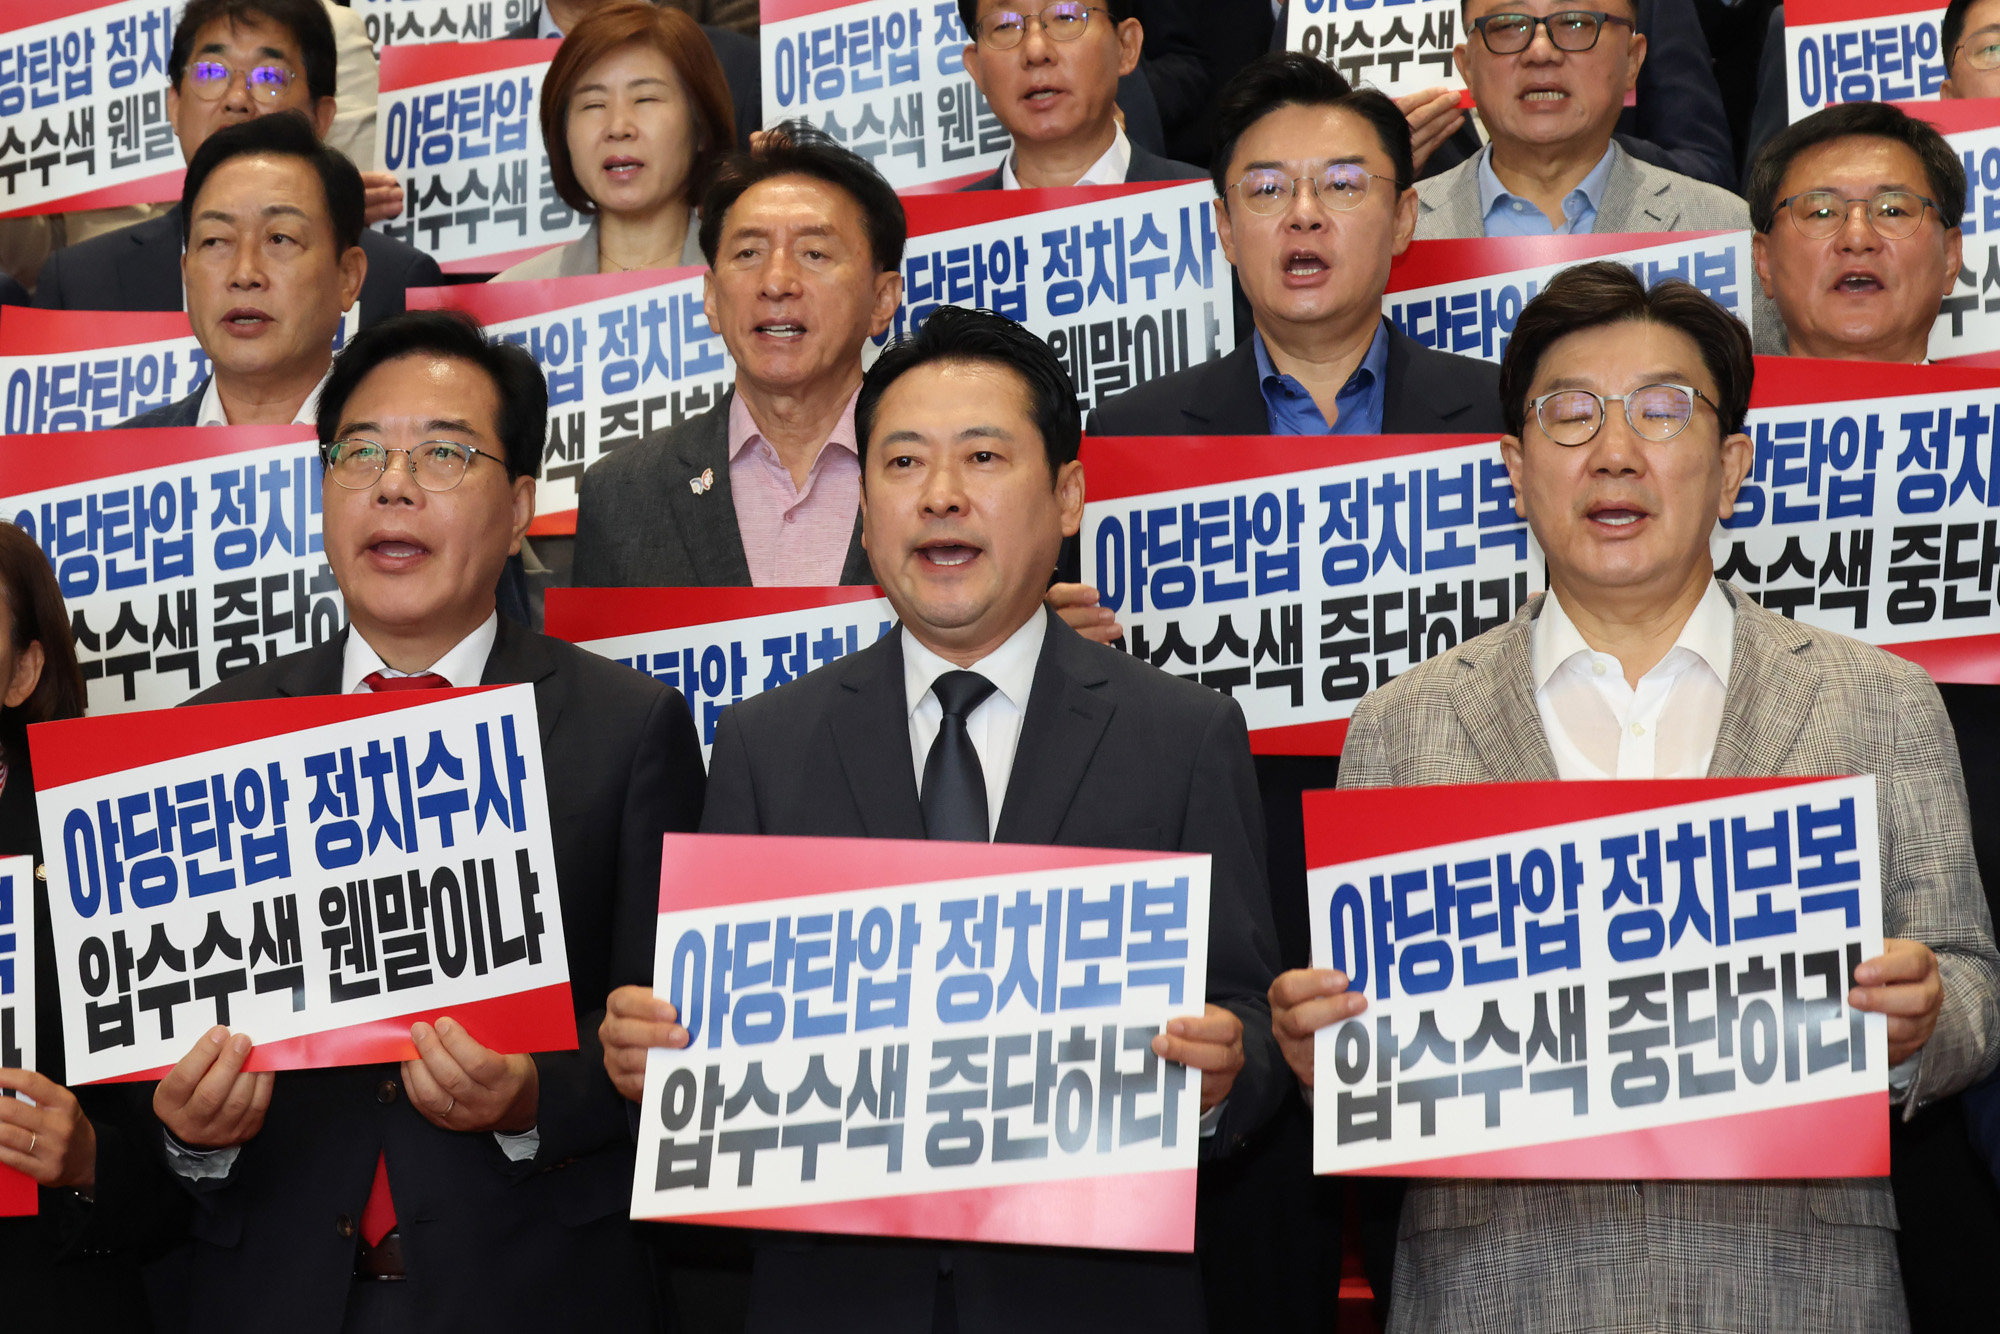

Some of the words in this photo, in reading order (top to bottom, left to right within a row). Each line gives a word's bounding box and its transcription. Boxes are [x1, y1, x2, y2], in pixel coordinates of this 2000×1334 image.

[106, 6, 172, 89] 정치
[775, 7, 922, 108] 야당탄압
[385, 76, 533, 171] 야당탄압
[1042, 201, 1216, 317] 정치수사
[598, 292, 732, 396] 정치보
[1896, 402, 2000, 515] 정치
[1096, 488, 1305, 614] 야당탄압
[1887, 518, 2000, 626] 중단
[63, 762, 292, 919] 야당탄압
[303, 714, 528, 870] 정치수사
[78, 893, 306, 1054] 압수수색
[318, 848, 546, 1004] 웬말이냐
[1329, 842, 1585, 1000] 야당탄압
[1600, 796, 1862, 964] 정치보복
[669, 902, 922, 1050] 야당탄압
[935, 876, 1190, 1025] 정치보복
[1334, 984, 1589, 1147] 압수수색
[1608, 943, 1868, 1109] 중단하라
[654, 1043, 910, 1192] 압수수색
[924, 1024, 1187, 1170] 중단하라
